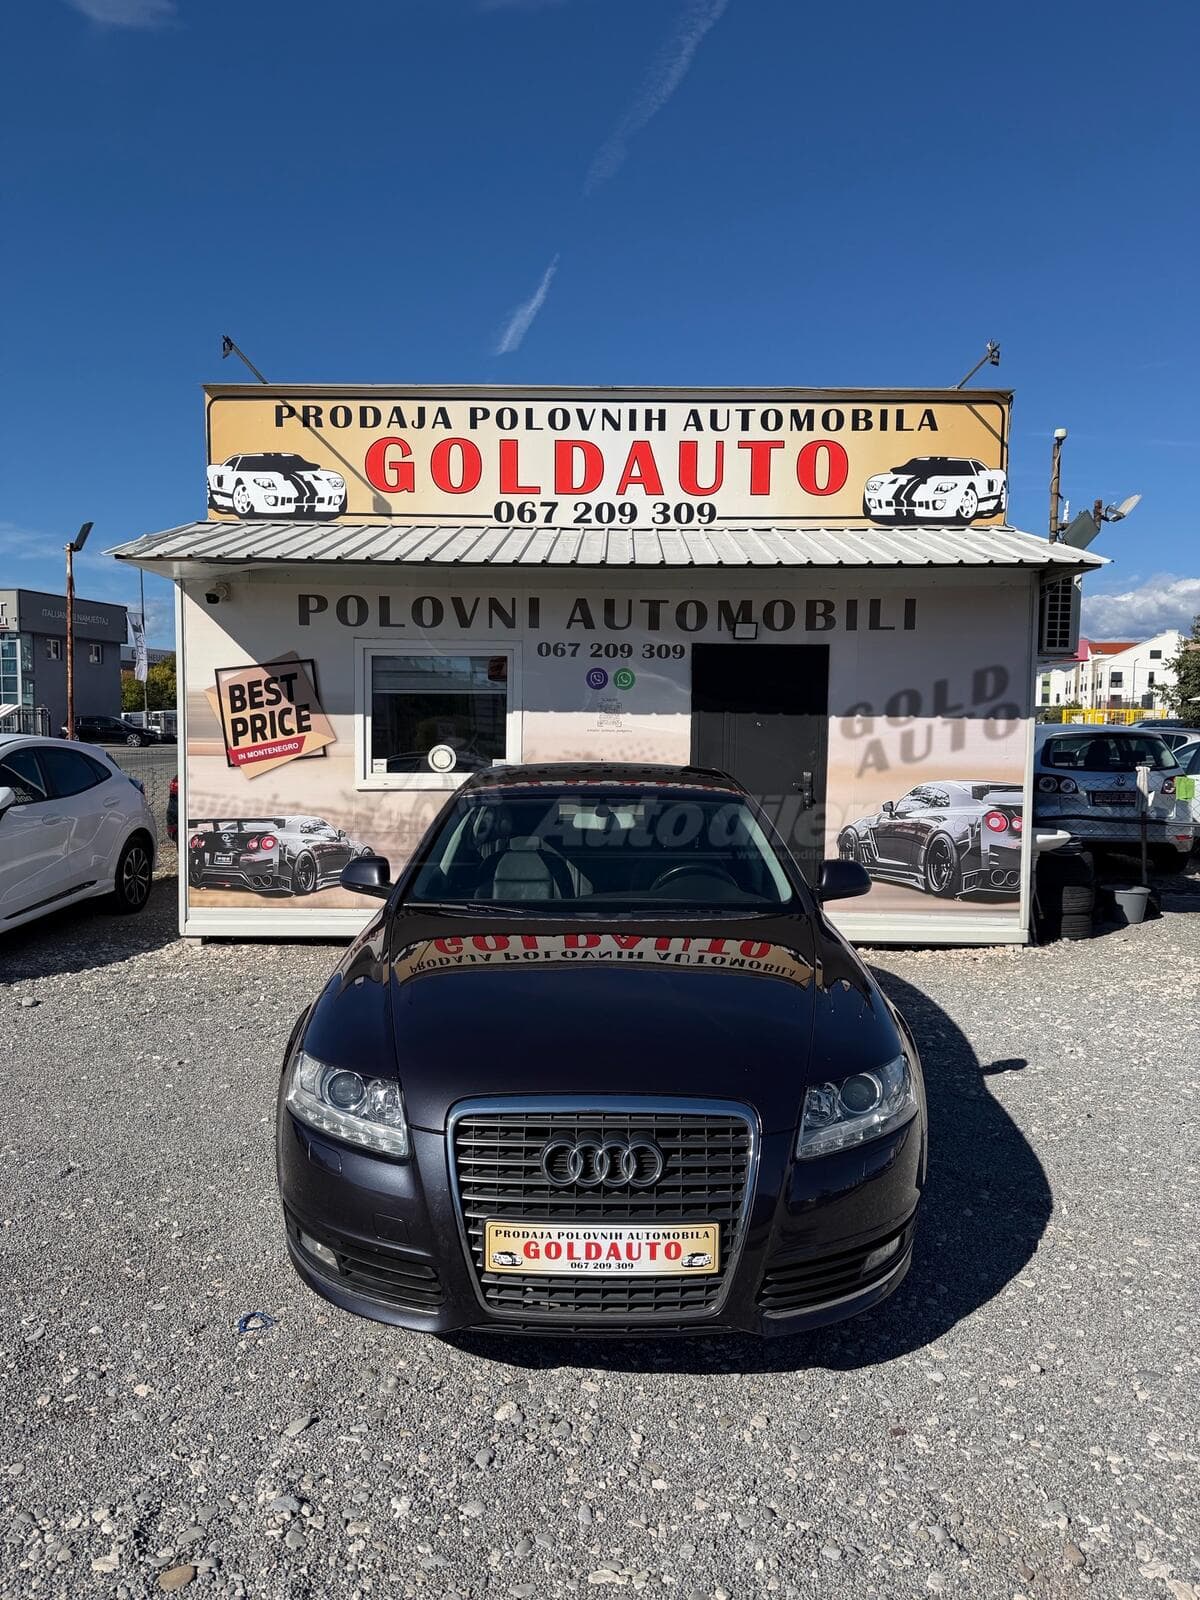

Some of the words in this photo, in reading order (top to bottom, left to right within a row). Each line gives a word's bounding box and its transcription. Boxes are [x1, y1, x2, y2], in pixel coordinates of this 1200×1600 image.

[274, 404, 453, 430] PRODAJA
[469, 407, 666, 432] POLOVNIH
[683, 408, 939, 432] AUTOMOBILA
[364, 436, 849, 497] GOLDAUTO
[493, 501, 559, 524] 067
[573, 501, 638, 525] 209
[651, 502, 718, 525] 309
[298, 593, 541, 630] POLOVNI
[566, 596, 917, 633] AUTOMOBILI
[537, 641, 581, 658] 067
[589, 643, 634, 659] 209
[641, 643, 686, 660] 309
[228, 672, 298, 714] BEST
[840, 664, 1010, 740] GOLD
[231, 703, 312, 747] PRICE
[247, 742, 299, 759] MONTENEGRO
[855, 701, 1021, 779] AUTO
[495, 1229, 553, 1240] PRODAJA
[557, 1231, 623, 1241] POLOVNIH
[627, 1230, 710, 1241] AUTOMOBILA
[523, 1240, 682, 1261] GOLDAUTO
[570, 1261, 589, 1270] 067
[593, 1262, 612, 1270] 209
[615, 1262, 634, 1270] 309
